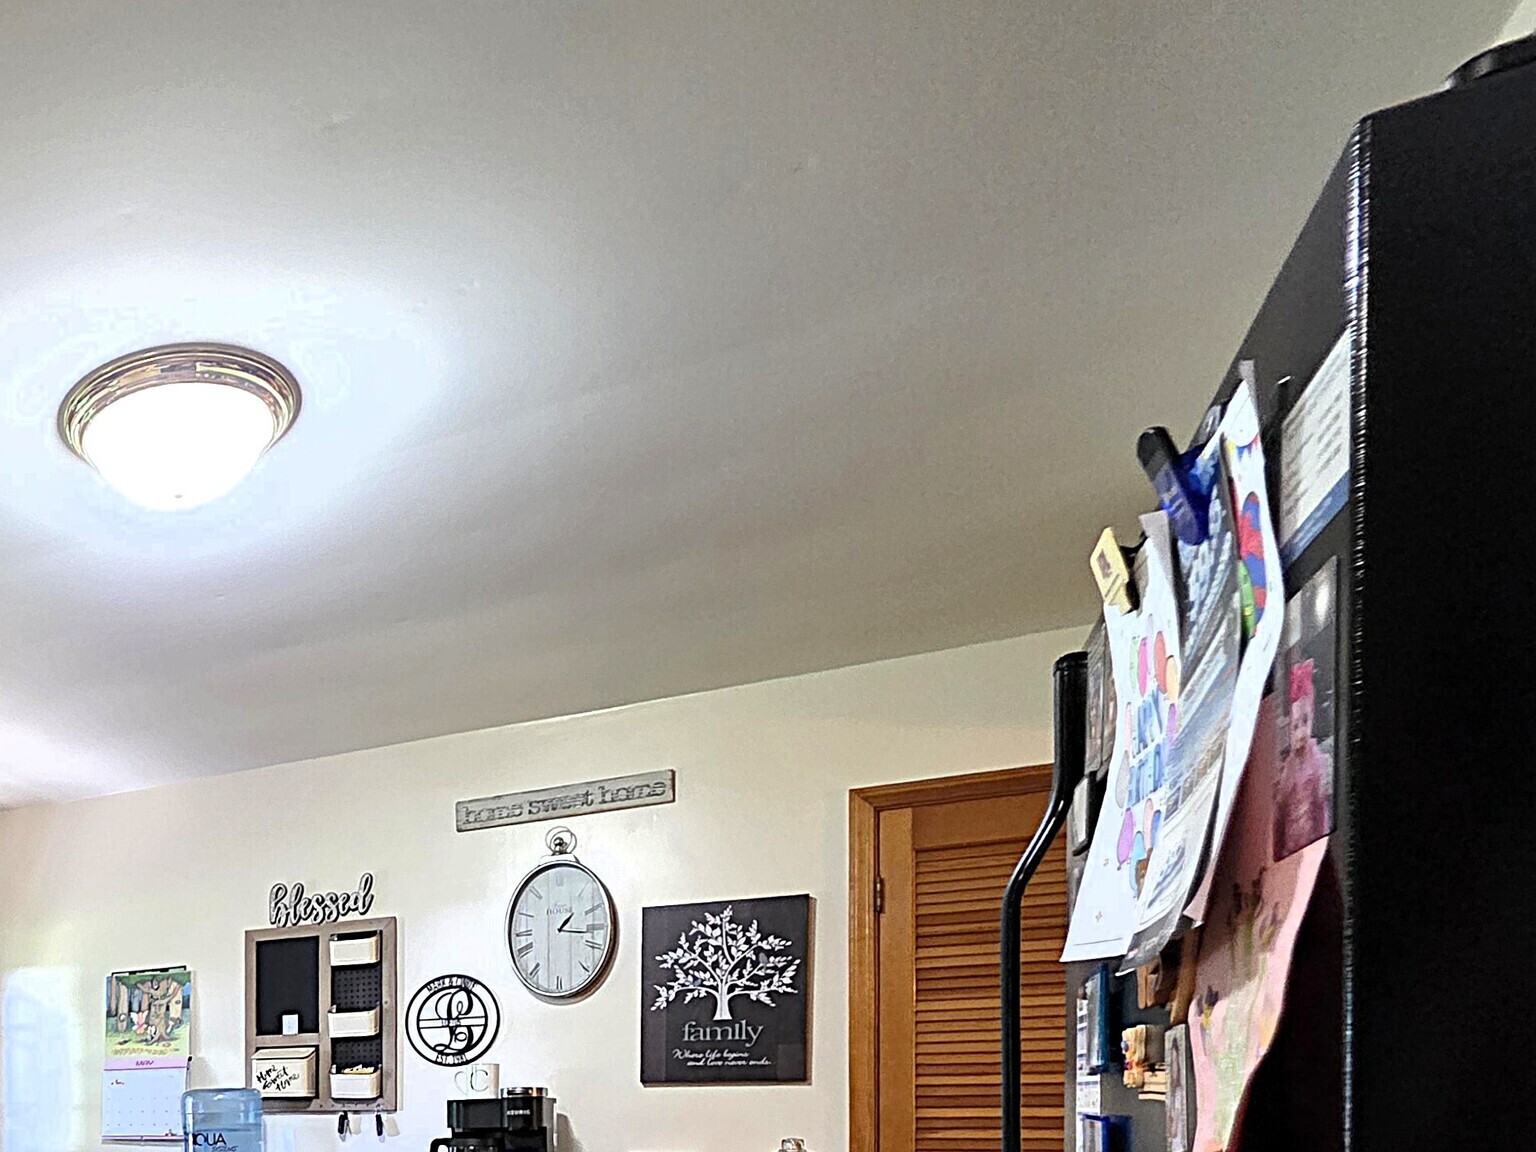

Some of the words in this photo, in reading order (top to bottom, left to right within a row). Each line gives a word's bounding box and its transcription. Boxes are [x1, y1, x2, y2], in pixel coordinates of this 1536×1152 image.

[269, 872, 374, 928] blessed
[682, 1019, 764, 1047] family
[705, 1049, 722, 1060] life
[723, 1049, 750, 1060] begins
